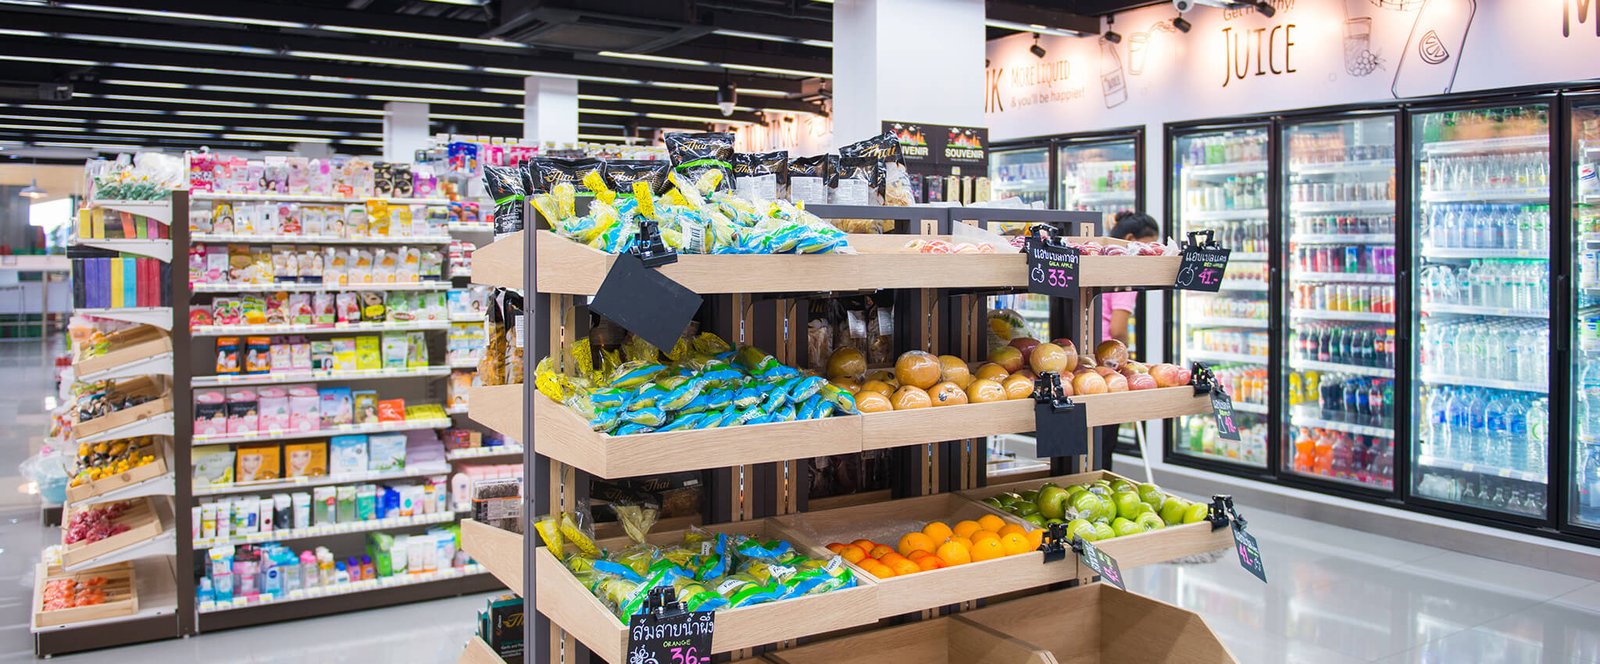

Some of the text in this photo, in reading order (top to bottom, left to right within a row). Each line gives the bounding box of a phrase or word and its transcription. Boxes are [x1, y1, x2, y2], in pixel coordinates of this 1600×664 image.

[1222, 24, 1296, 87] JUICE
[1039, 91, 1049, 104] be
[945, 148, 984, 159] SOUVENIR
[1048, 268, 1073, 287] 33.-
[633, 611, 714, 641] ส้มสายน้ำผึ้ง
[663, 639, 691, 648] ORANGE
